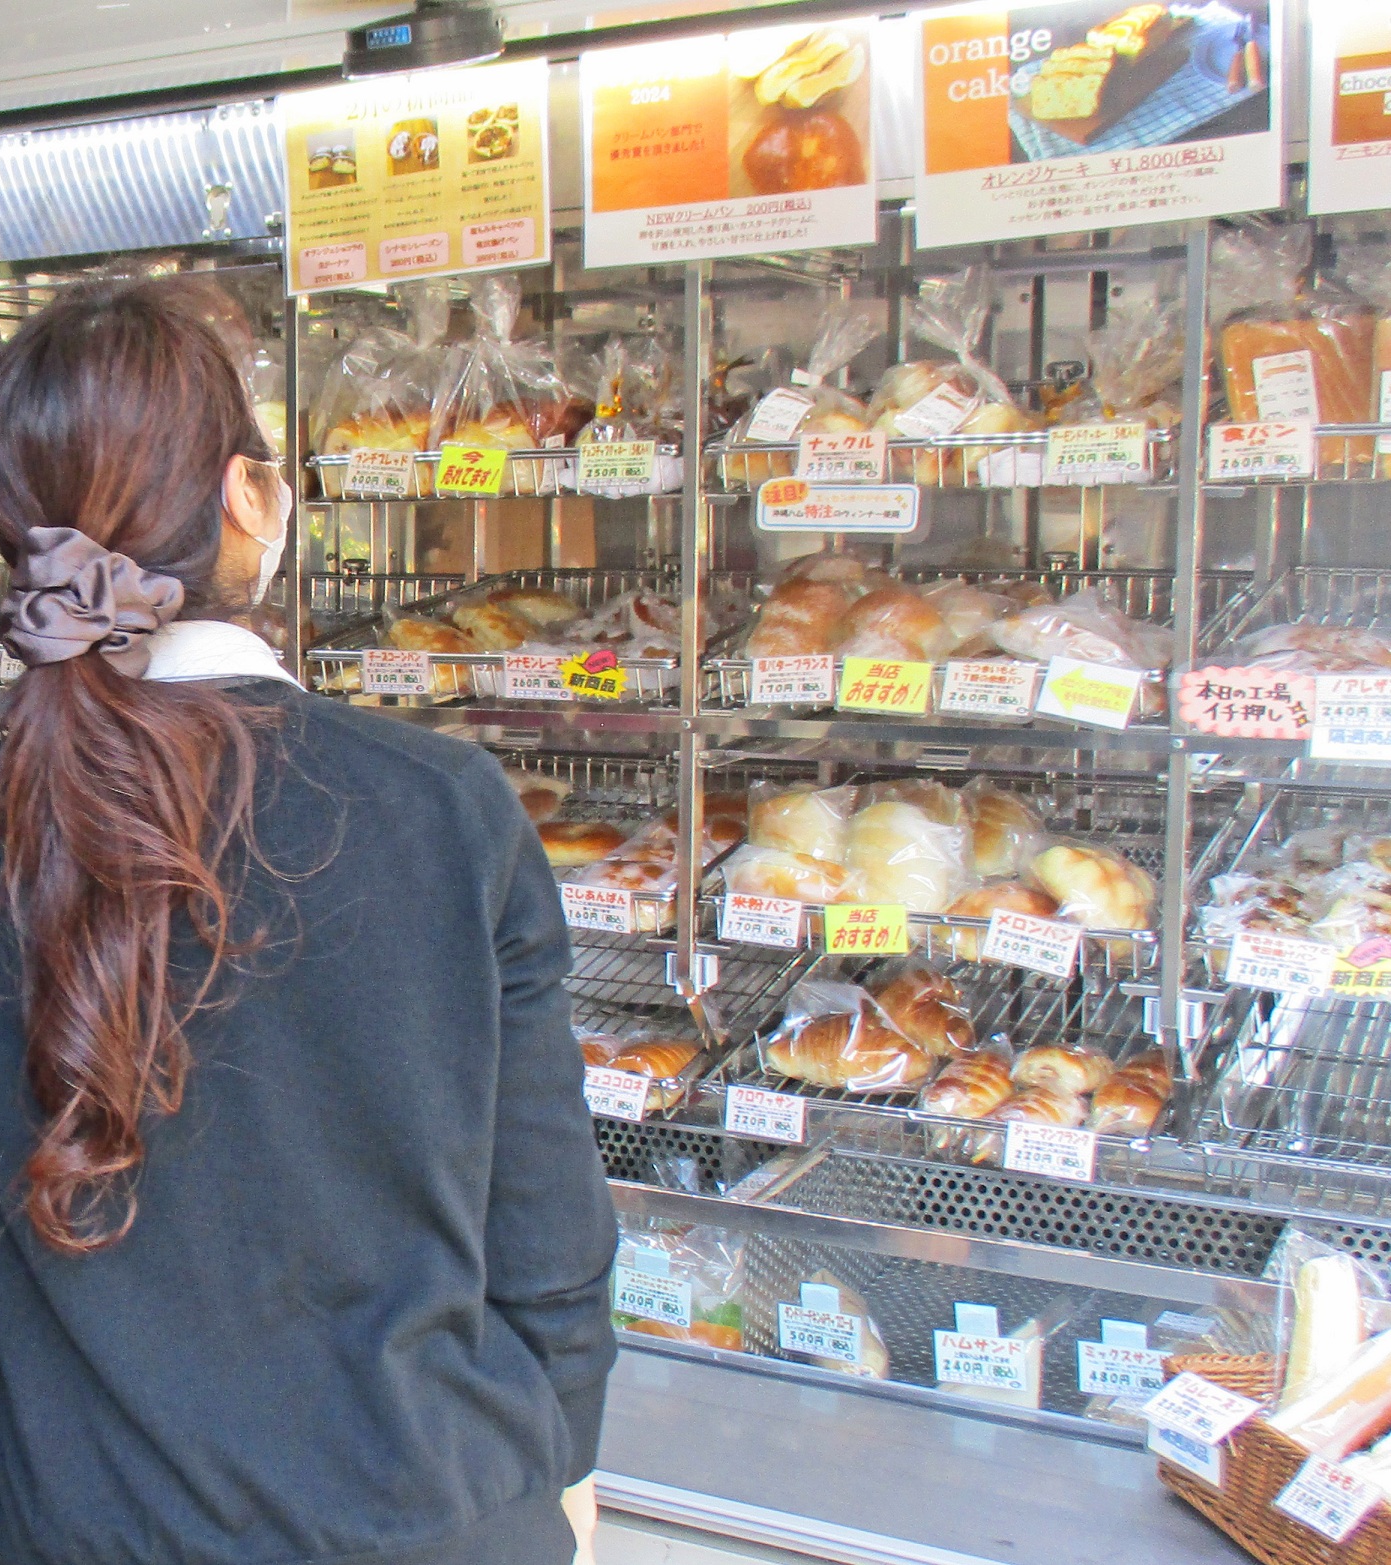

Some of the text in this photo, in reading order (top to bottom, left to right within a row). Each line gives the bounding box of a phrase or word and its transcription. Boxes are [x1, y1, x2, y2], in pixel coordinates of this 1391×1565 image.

[929, 25, 1053, 66] orange
[948, 68, 1032, 102] cake
[630, 86, 671, 105] 2024
[981, 162, 1090, 190] オレンジケーキ
[808, 435, 874, 450] ナックル
[765, 483, 807, 504] 注目!
[867, 664, 903, 680] 当店
[569, 673, 617, 693] 新商品
[845, 679, 924, 706] おすすめ!
[1196, 680, 1291, 702] 本日の工場
[1332, 679, 1391, 694] ノアレザ
[1203, 702, 1283, 722] イチ押し
[564, 887, 627, 905] こしあんぱん
[732, 896, 796, 914] 米粉パン
[847, 909, 879, 924] 当店
[833, 926, 902, 949] おすすめ!
[997, 914, 1074, 942] メロンパン
[736, 1089, 795, 1109] クロワッサン
[942, 1335, 1021, 1355] ハムサンド
[1180, 1377, 1245, 1412] ラムレーズン
